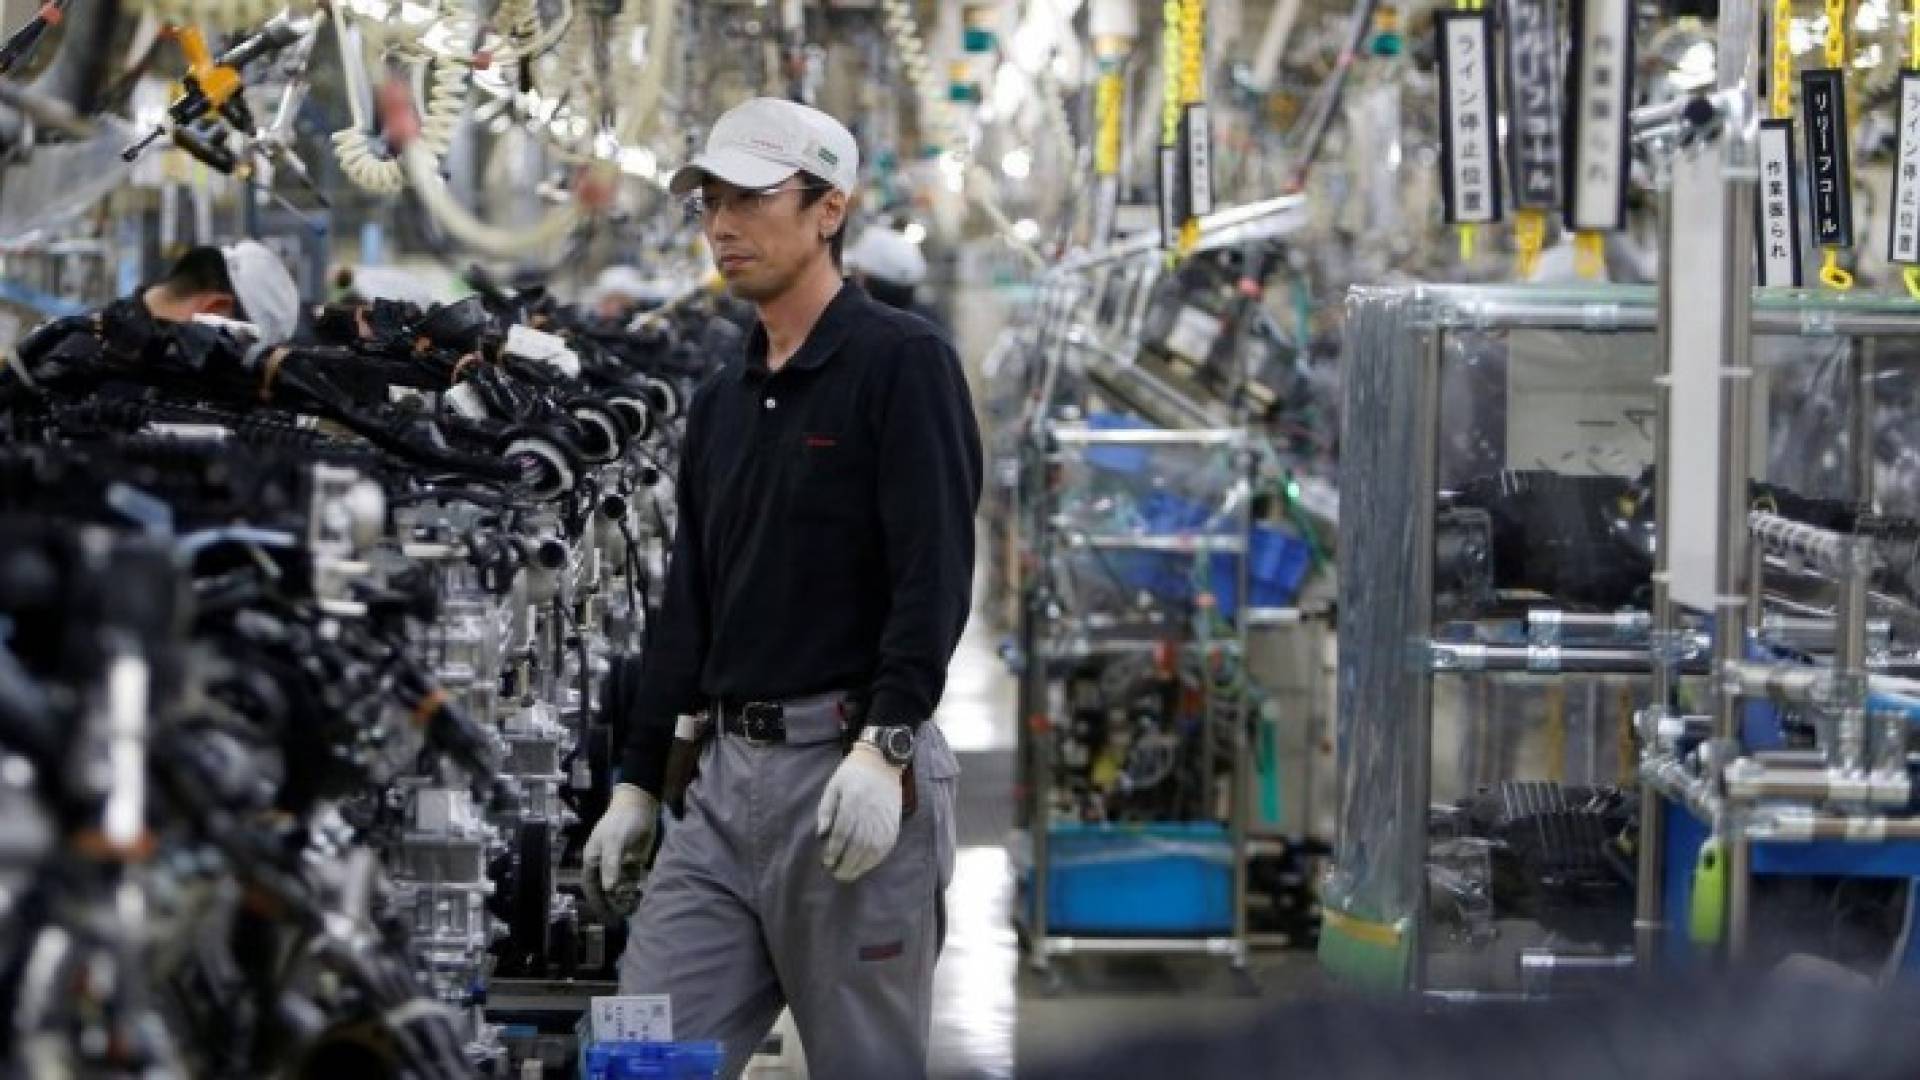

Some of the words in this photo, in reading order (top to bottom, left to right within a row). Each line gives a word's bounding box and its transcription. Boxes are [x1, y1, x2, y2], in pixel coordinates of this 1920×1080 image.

[1456, 34, 1482, 212] ライン停止位置
[1815, 91, 1838, 234] リリーフコール
